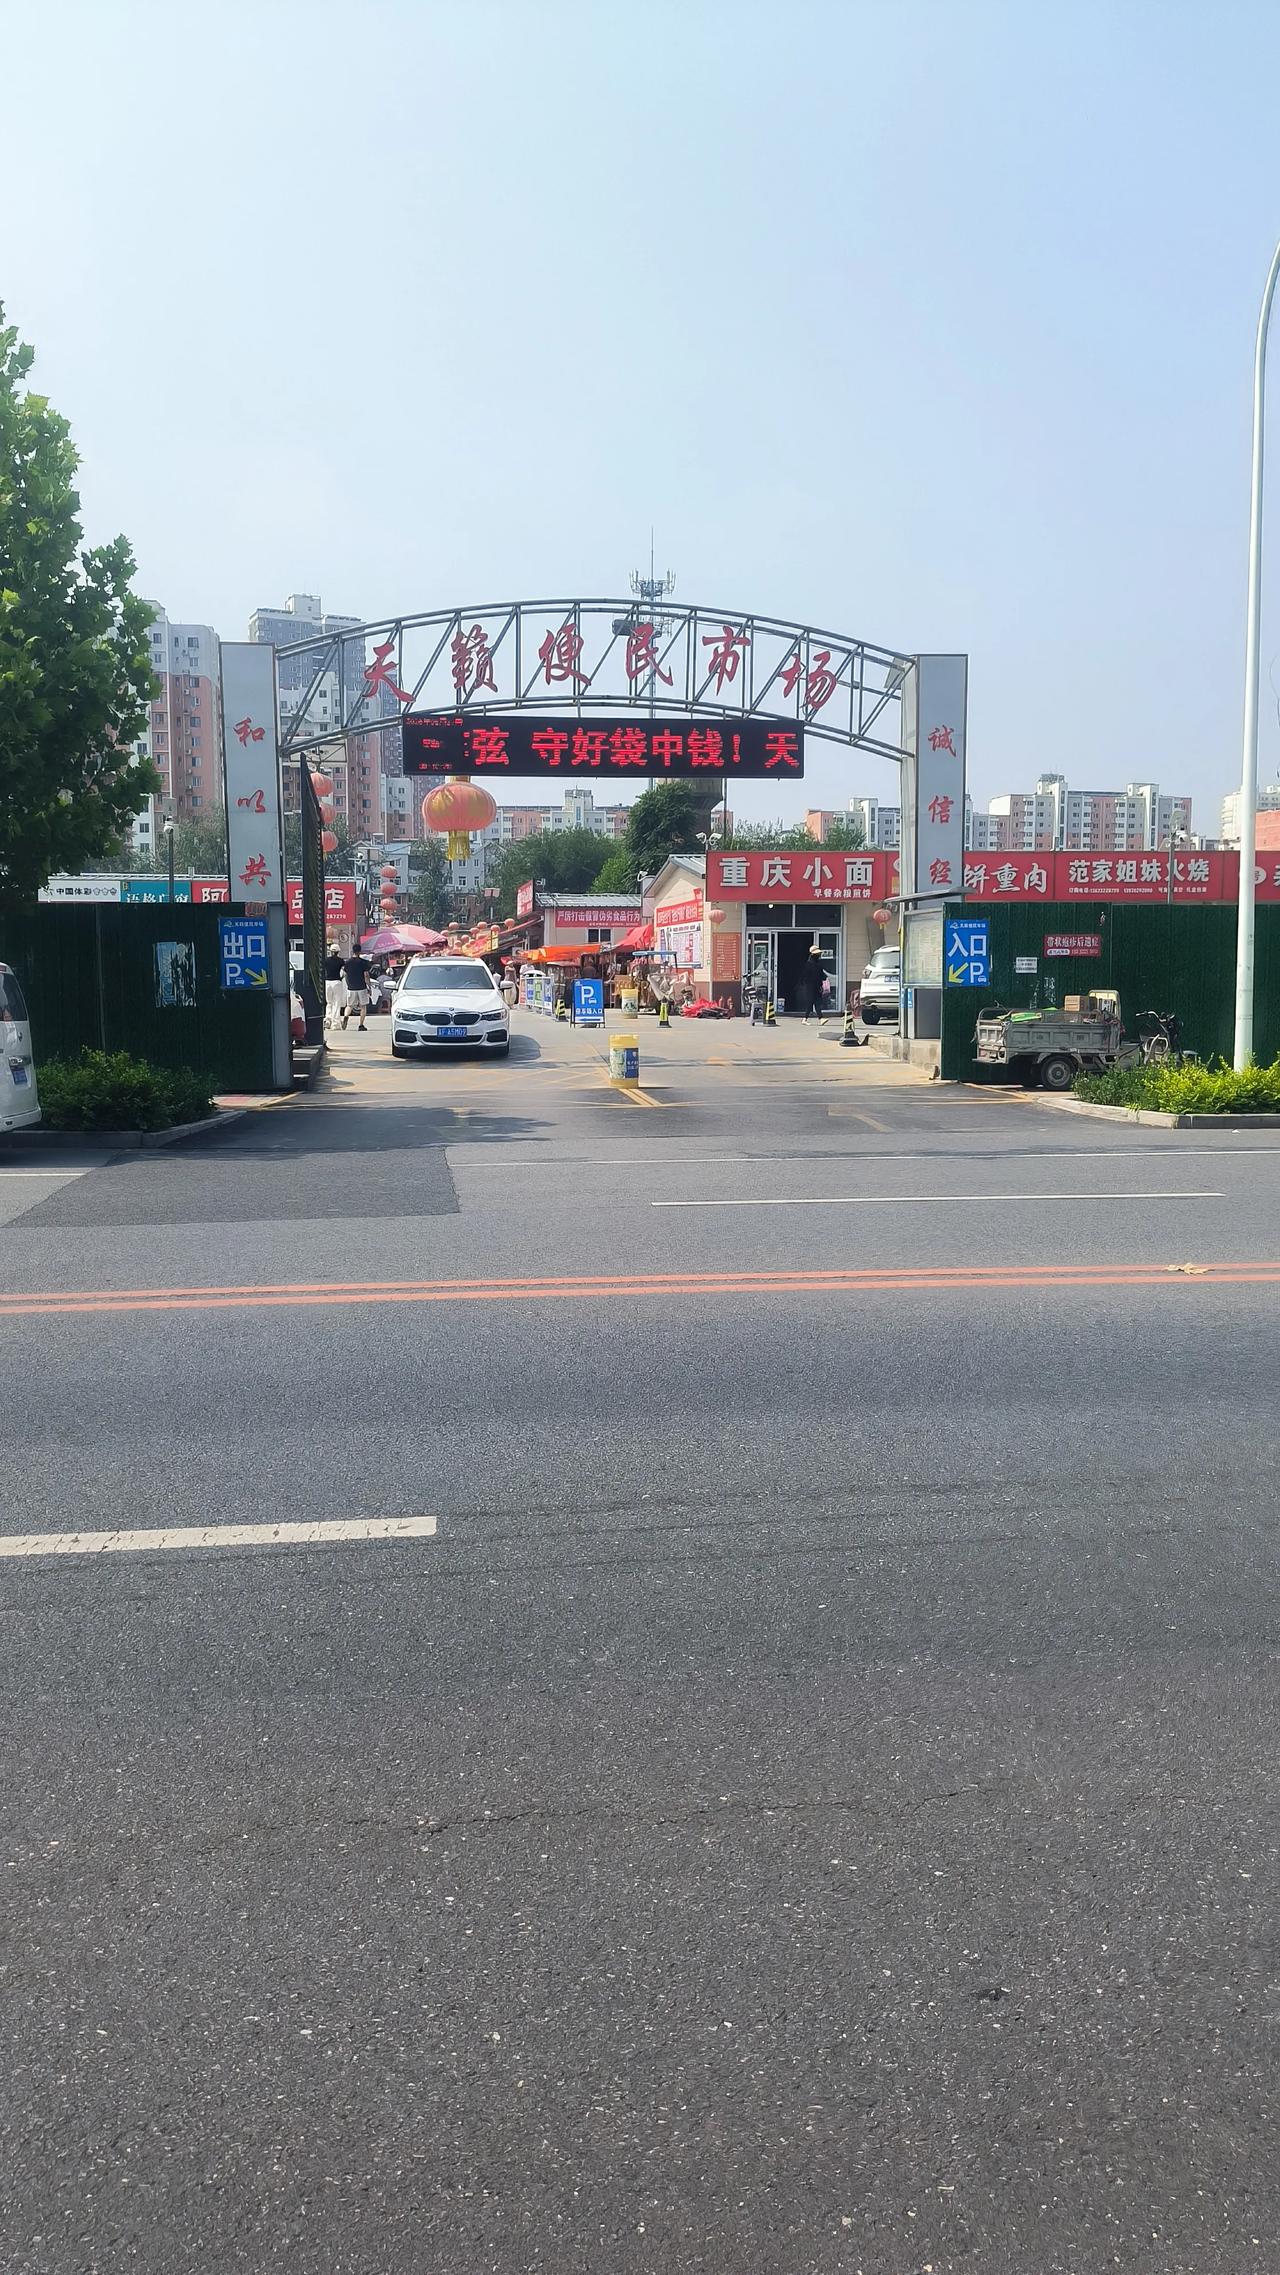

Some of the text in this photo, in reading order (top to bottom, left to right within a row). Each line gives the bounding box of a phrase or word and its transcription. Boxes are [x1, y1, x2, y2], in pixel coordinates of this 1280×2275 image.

[363, 622, 840, 712] 天籁便民市场
[464, 727, 510, 765] 弦
[719, 856, 875, 888] 重庆小面
[1068, 858, 1209, 883] 范家姐妹火烧
[56, 887, 92, 896] 中国体彩
[813, 888, 871, 898] 早餐杂粮煎饼
[223, 931, 266, 960] 出口
[947, 932, 987, 958] 入口
[225, 963, 241, 986] P
[969, 962, 984, 984] P
[581, 985, 594, 1005] P
